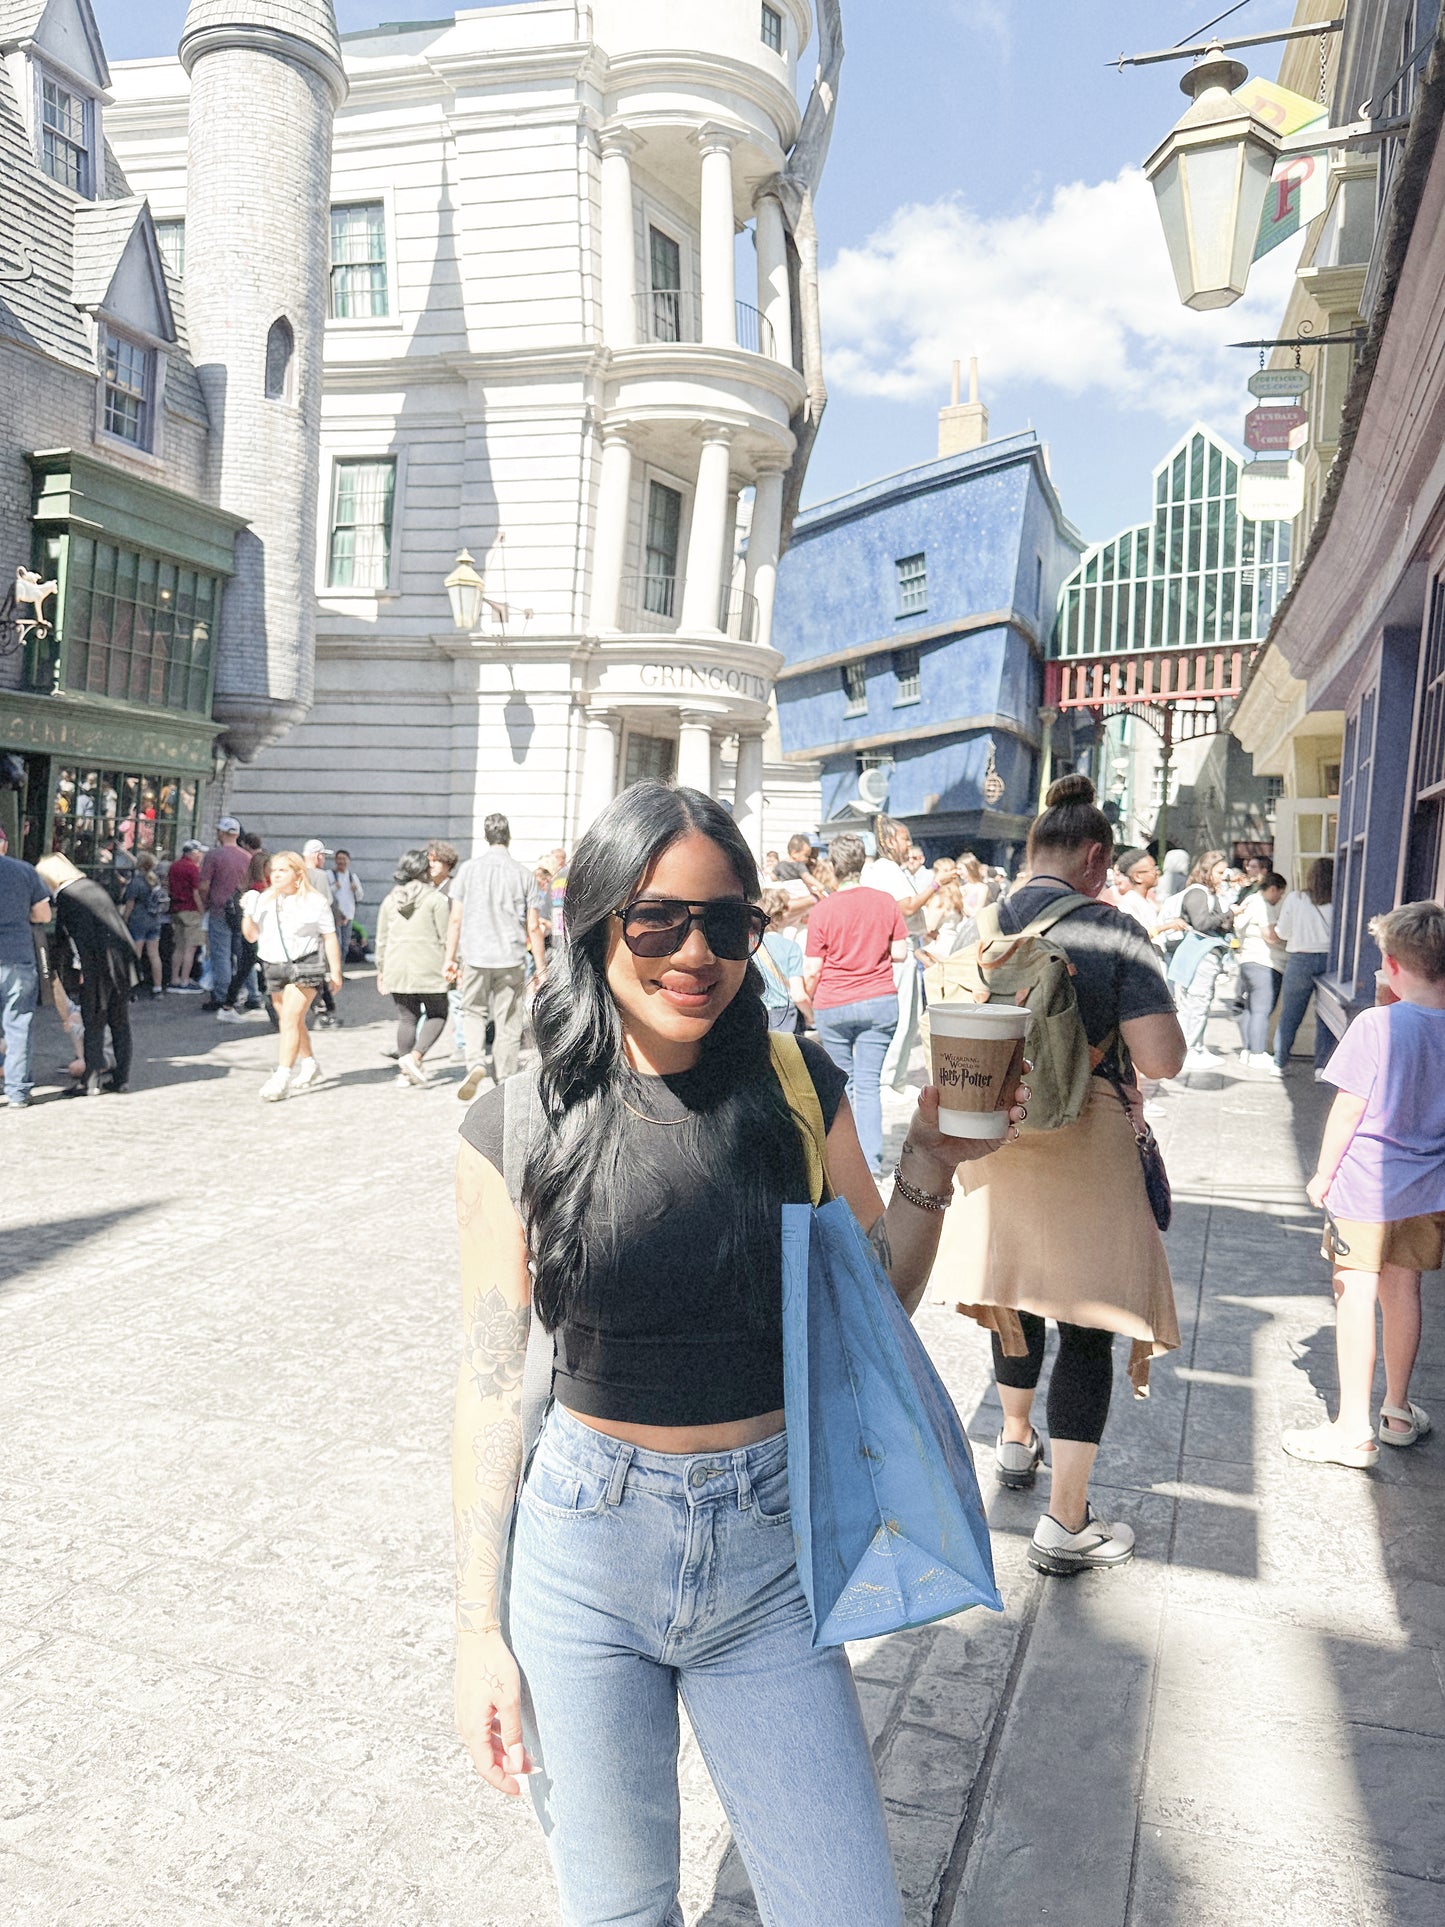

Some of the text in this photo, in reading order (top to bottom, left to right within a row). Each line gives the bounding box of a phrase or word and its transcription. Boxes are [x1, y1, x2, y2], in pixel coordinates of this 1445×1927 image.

[1255, 413, 1298, 421] SUNDAES
[640, 663, 766, 700] GRINGOTTS
[939, 1067, 993, 1092] Harry Potter
